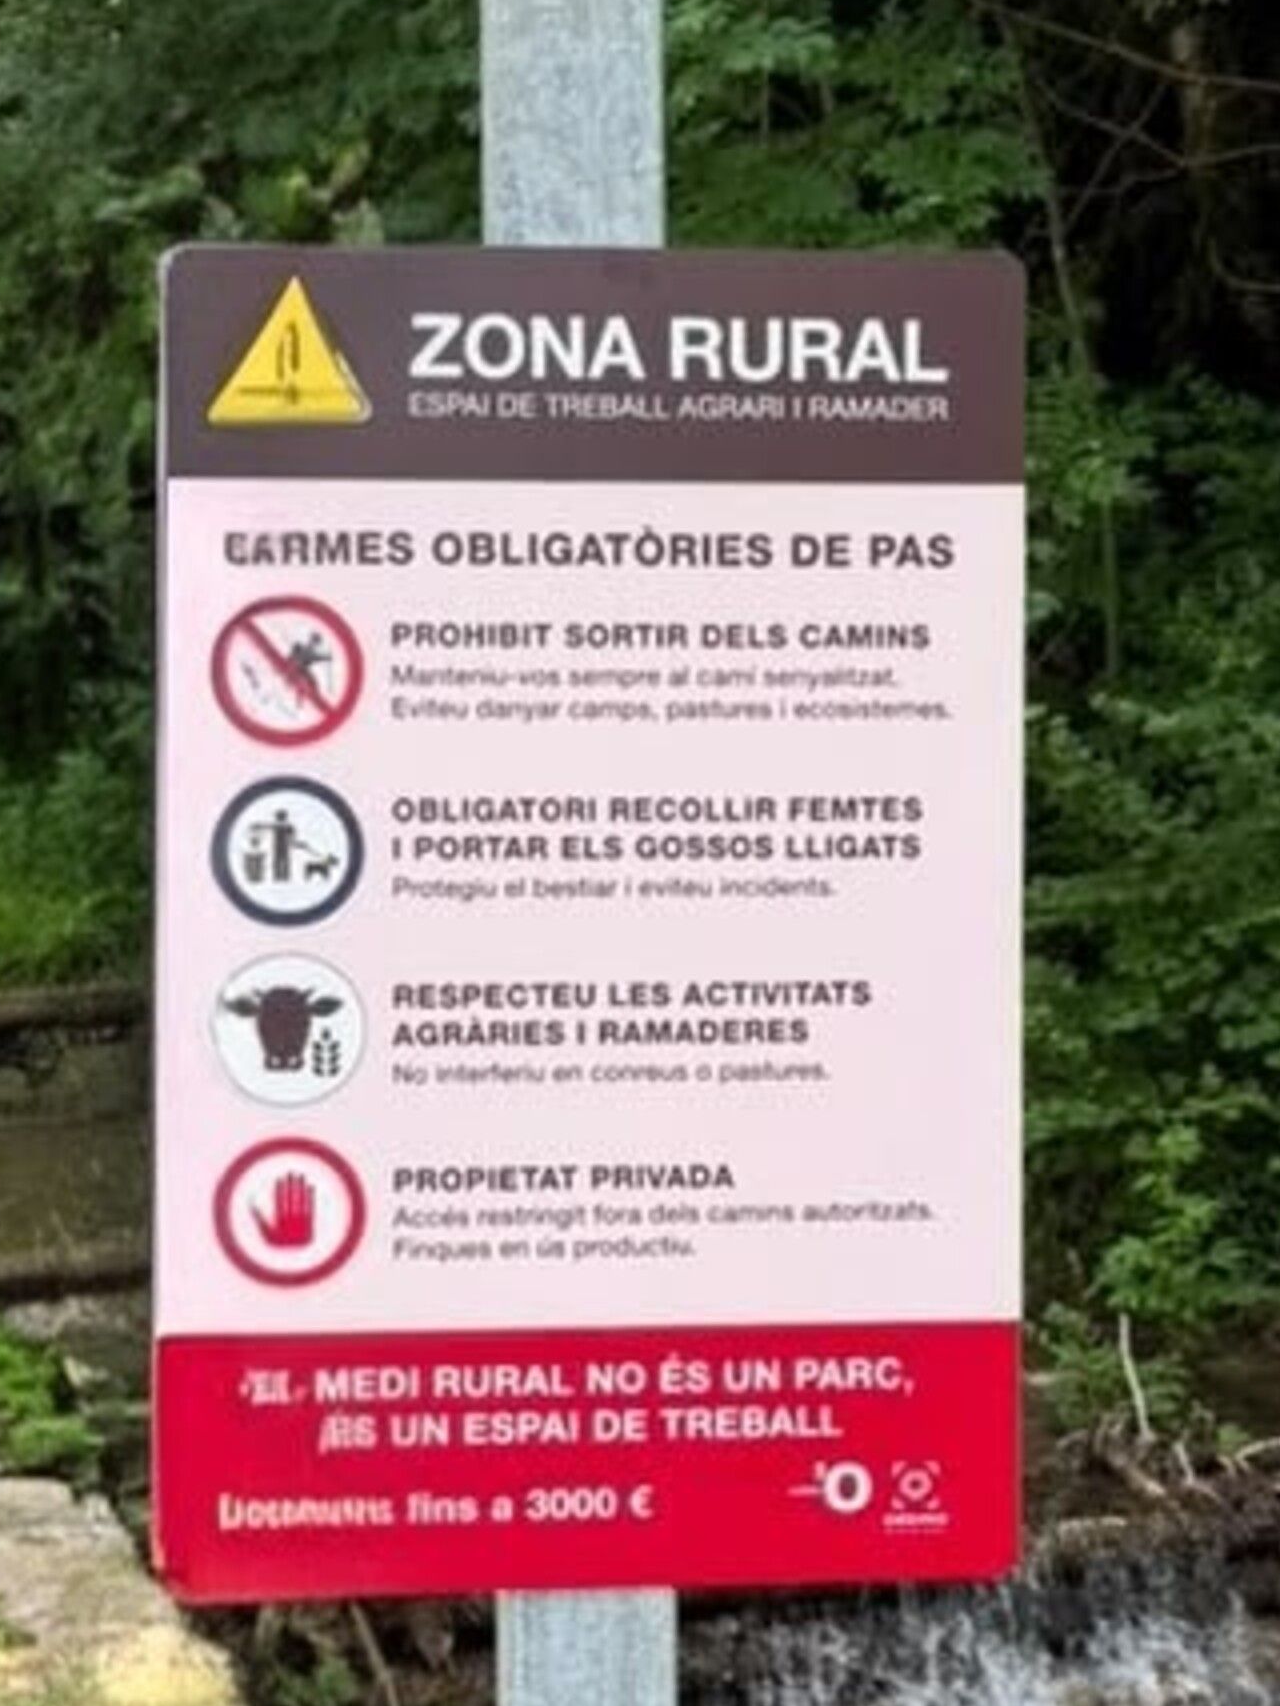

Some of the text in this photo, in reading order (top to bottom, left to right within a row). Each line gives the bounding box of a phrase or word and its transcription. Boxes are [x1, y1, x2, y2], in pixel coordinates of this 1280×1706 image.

[409, 313, 949, 383] ZONA RURAL
[408, 390, 949, 421] ESPAI DE TREBALL AGRARI I RAMADER
[431, 526, 774, 569] OBLIGATÒRIES
[790, 533, 851, 568] DE
[869, 533, 954, 569] PAS
[390, 621, 931, 650] PROHIBIT SORTIR DELS CAMINS
[568, 668, 662, 690] sempre
[668, 666, 690, 688] al
[390, 695, 469, 720] Eviteu
[475, 699, 561, 723] danyar
[664, 699, 773, 723] pastures
[391, 795, 923, 824] OBLIGATORI RECOLLIR FEMTES
[391, 833, 921, 862] I PORTAR ELS GOSSOS LLIGATS
[391, 875, 498, 904] Protegiu
[503, 877, 526, 899] el
[532, 878, 618, 899] bestiar
[637, 878, 713, 898] eviteu
[392, 980, 872, 1010] RESPECTEU LES ACTIVITATS
[392, 1017, 809, 1047] AGRÀRIES I RAMADERES
[391, 1063, 428, 1086] No
[551, 1065, 583, 1083] en
[694, 1063, 713, 1083] o
[392, 1163, 735, 1193] PROPIETAT PRIVADA
[592, 1203, 643, 1226] fora
[648, 1203, 701, 1225] dels
[706, 1204, 795, 1224] camins
[392, 1237, 493, 1263] Finques
[498, 1240, 530, 1259] en
[314, 1367, 420, 1402] MEDI
[432, 1364, 572, 1398] RURAL
[586, 1362, 647, 1395] NO
[658, 1353, 712, 1394] ÉS
[723, 1360, 781, 1393] UN
[793, 1356, 912, 1390] PARC,
[390, 1414, 450, 1447] UN
[462, 1411, 579, 1445] ESPAI
[593, 1408, 646, 1442] DE
[660, 1405, 841, 1439] TREBALL
[490, 1496, 514, 1522] a
[525, 1486, 618, 1521] 3000
[628, 1485, 651, 1518] €
